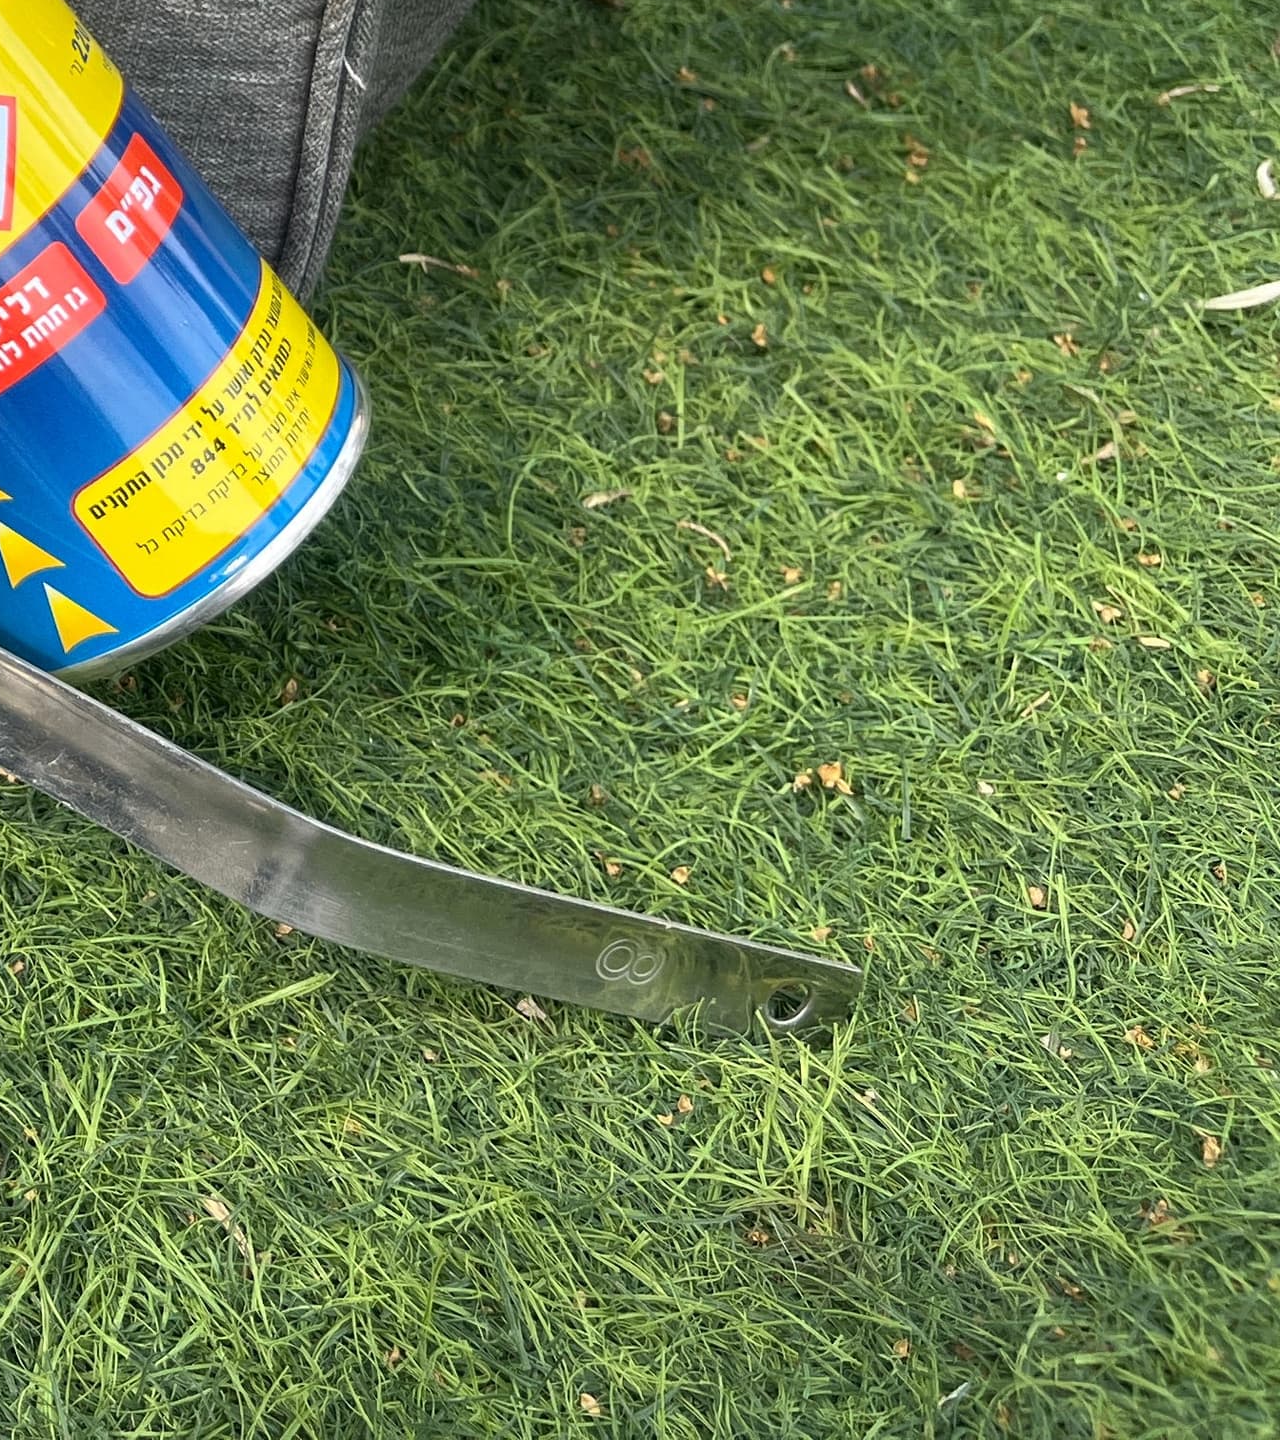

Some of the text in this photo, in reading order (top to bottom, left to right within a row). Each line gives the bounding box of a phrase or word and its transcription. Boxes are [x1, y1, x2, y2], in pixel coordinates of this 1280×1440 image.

[104, 165, 163, 245] גפ"ם
[64, 286, 89, 311] גז
[20, 303, 69, 349] תחת
[249, 328, 273, 369] נבדק
[258, 337, 292, 397] כמתאים
[223, 359, 256, 400] ואושר
[199, 399, 225, 422] על
[284, 387, 301, 413] אינו
[182, 419, 203, 441] ידי
[250, 407, 311, 486] יחידות המוצר
[262, 411, 288, 442] מעיד
[150, 442, 185, 480] מכון
[190, 436, 227, 480] 844.
[242, 442, 263, 463] על
[88, 470, 152, 520] התקנים
[207, 462, 248, 505] בדיקת
[161, 502, 207, 542] בדיקת
[135, 538, 160, 555] כל
